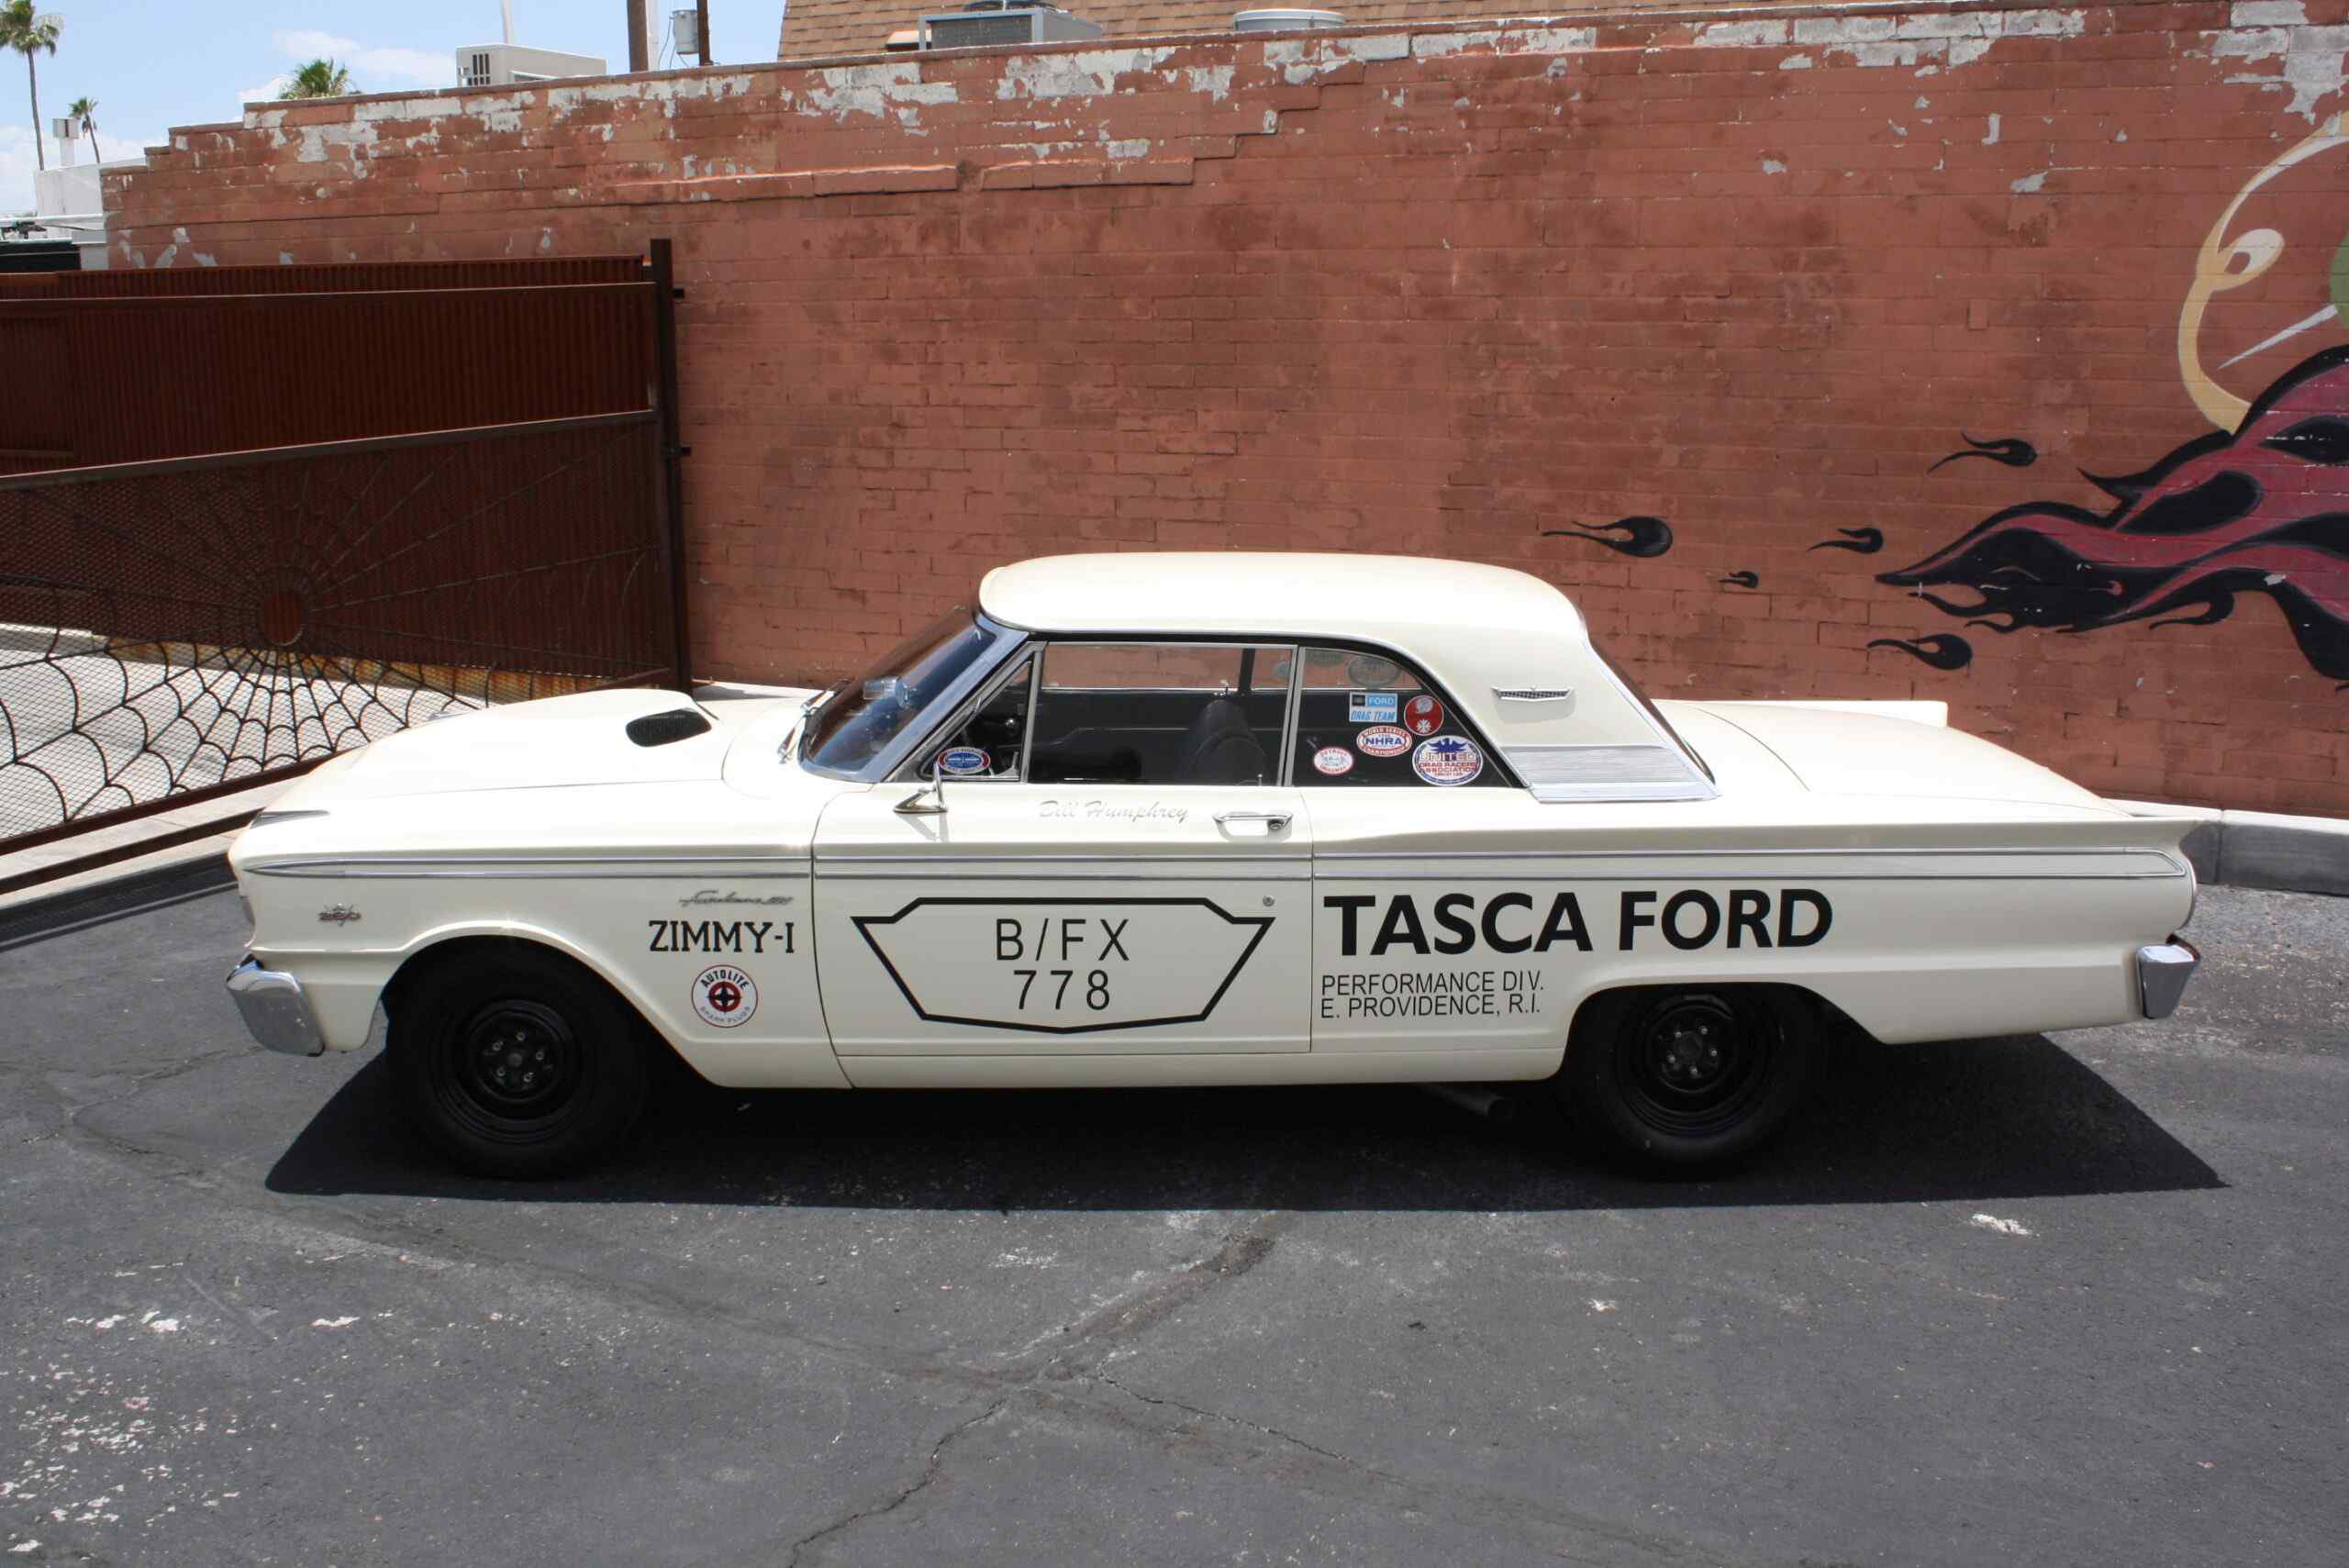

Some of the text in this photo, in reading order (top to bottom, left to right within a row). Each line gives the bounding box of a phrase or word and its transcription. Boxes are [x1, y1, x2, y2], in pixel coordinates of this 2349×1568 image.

[1368, 696, 1395, 706] FORD
[1351, 711, 1395, 720] DRAG TEAM
[1365, 737, 1402, 745] NHRA
[1419, 752, 1476, 762] UNITED
[1085, 800, 1189, 824] Humphrey
[1323, 888, 1833, 956] TASCA FORD
[649, 920, 795, 953] ZIMMY-I
[996, 918, 1130, 961] B/FX
[700, 969, 750, 989] AUTOLITE
[1012, 970, 1110, 1010] 778
[1321, 970, 1544, 995] PERFORMANCE DIV.
[1320, 993, 1541, 1018] E. PROVIDENCE, R.I.
